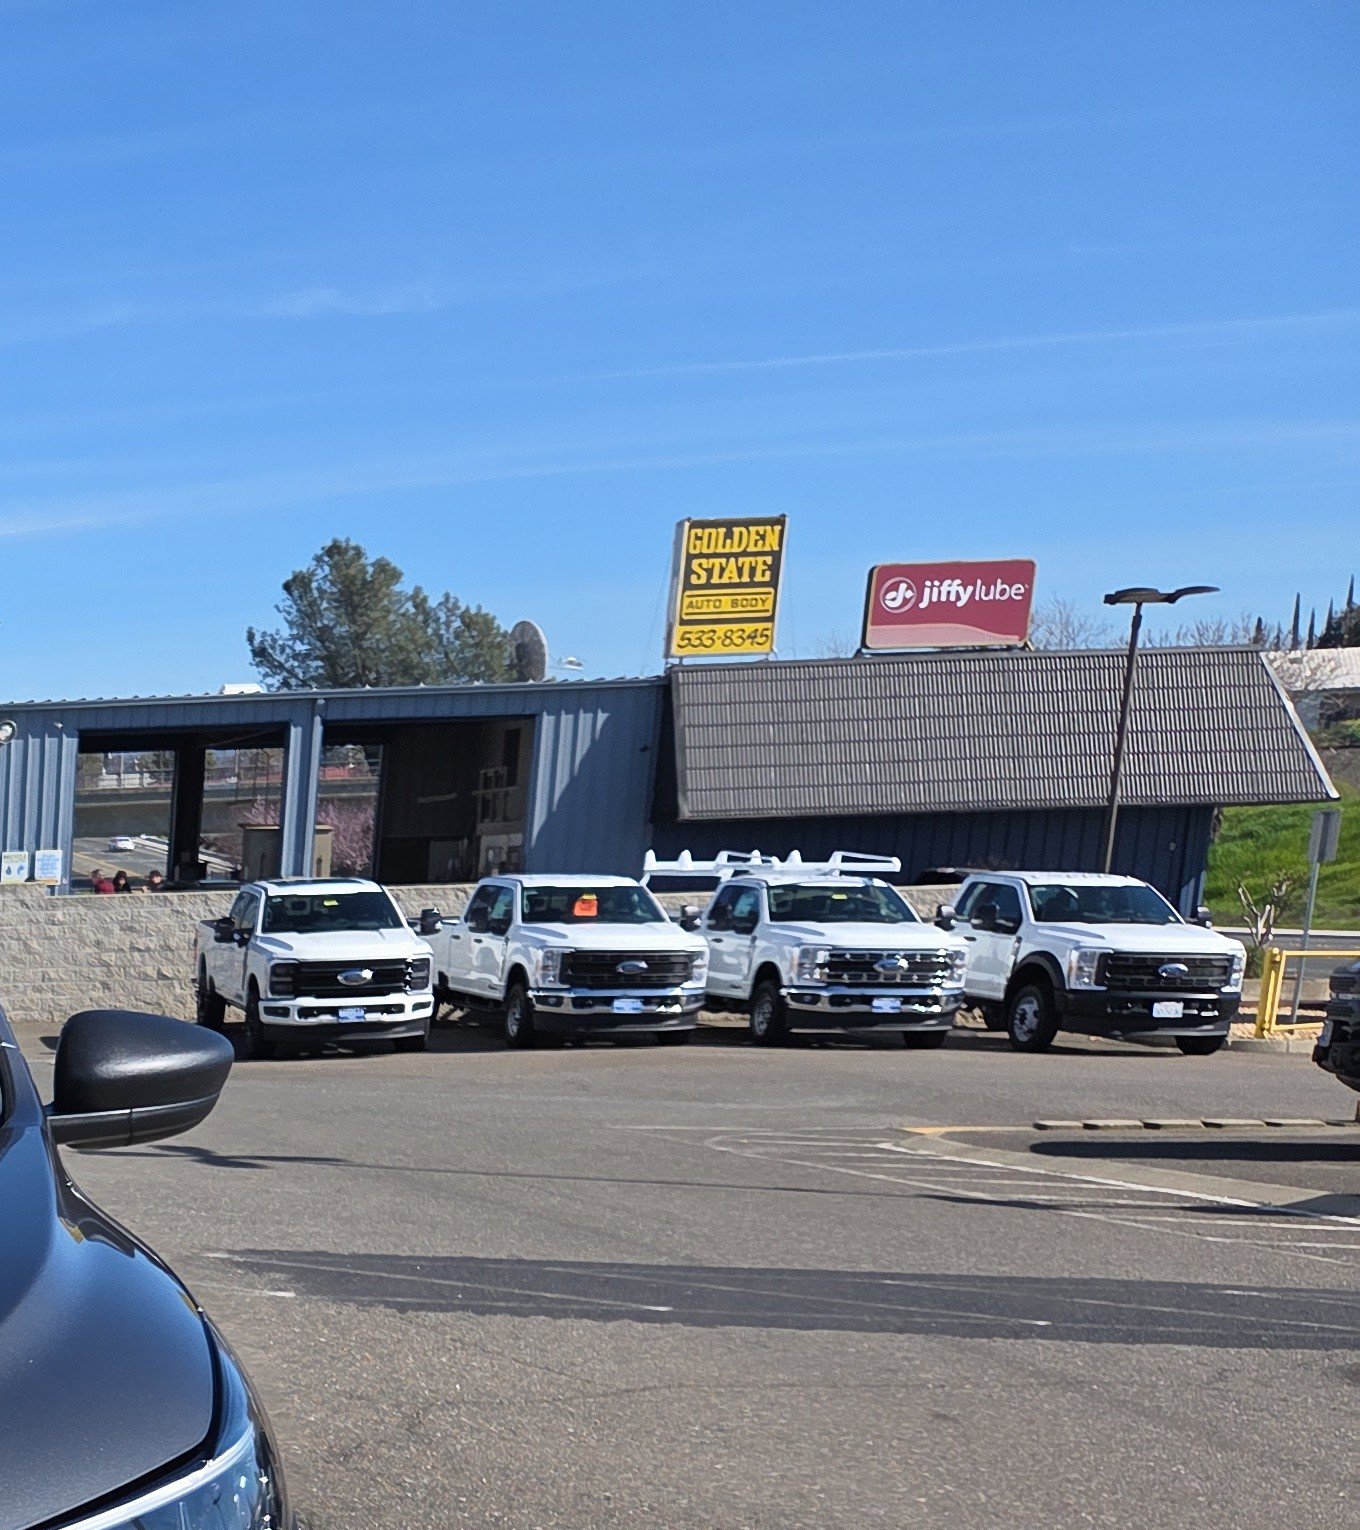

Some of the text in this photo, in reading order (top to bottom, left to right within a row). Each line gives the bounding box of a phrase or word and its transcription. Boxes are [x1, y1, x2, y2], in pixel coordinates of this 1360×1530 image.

[688, 524, 782, 555] GOLDEN
[690, 555, 772, 585] STATE
[685, 597, 769, 610] AUTO BODY
